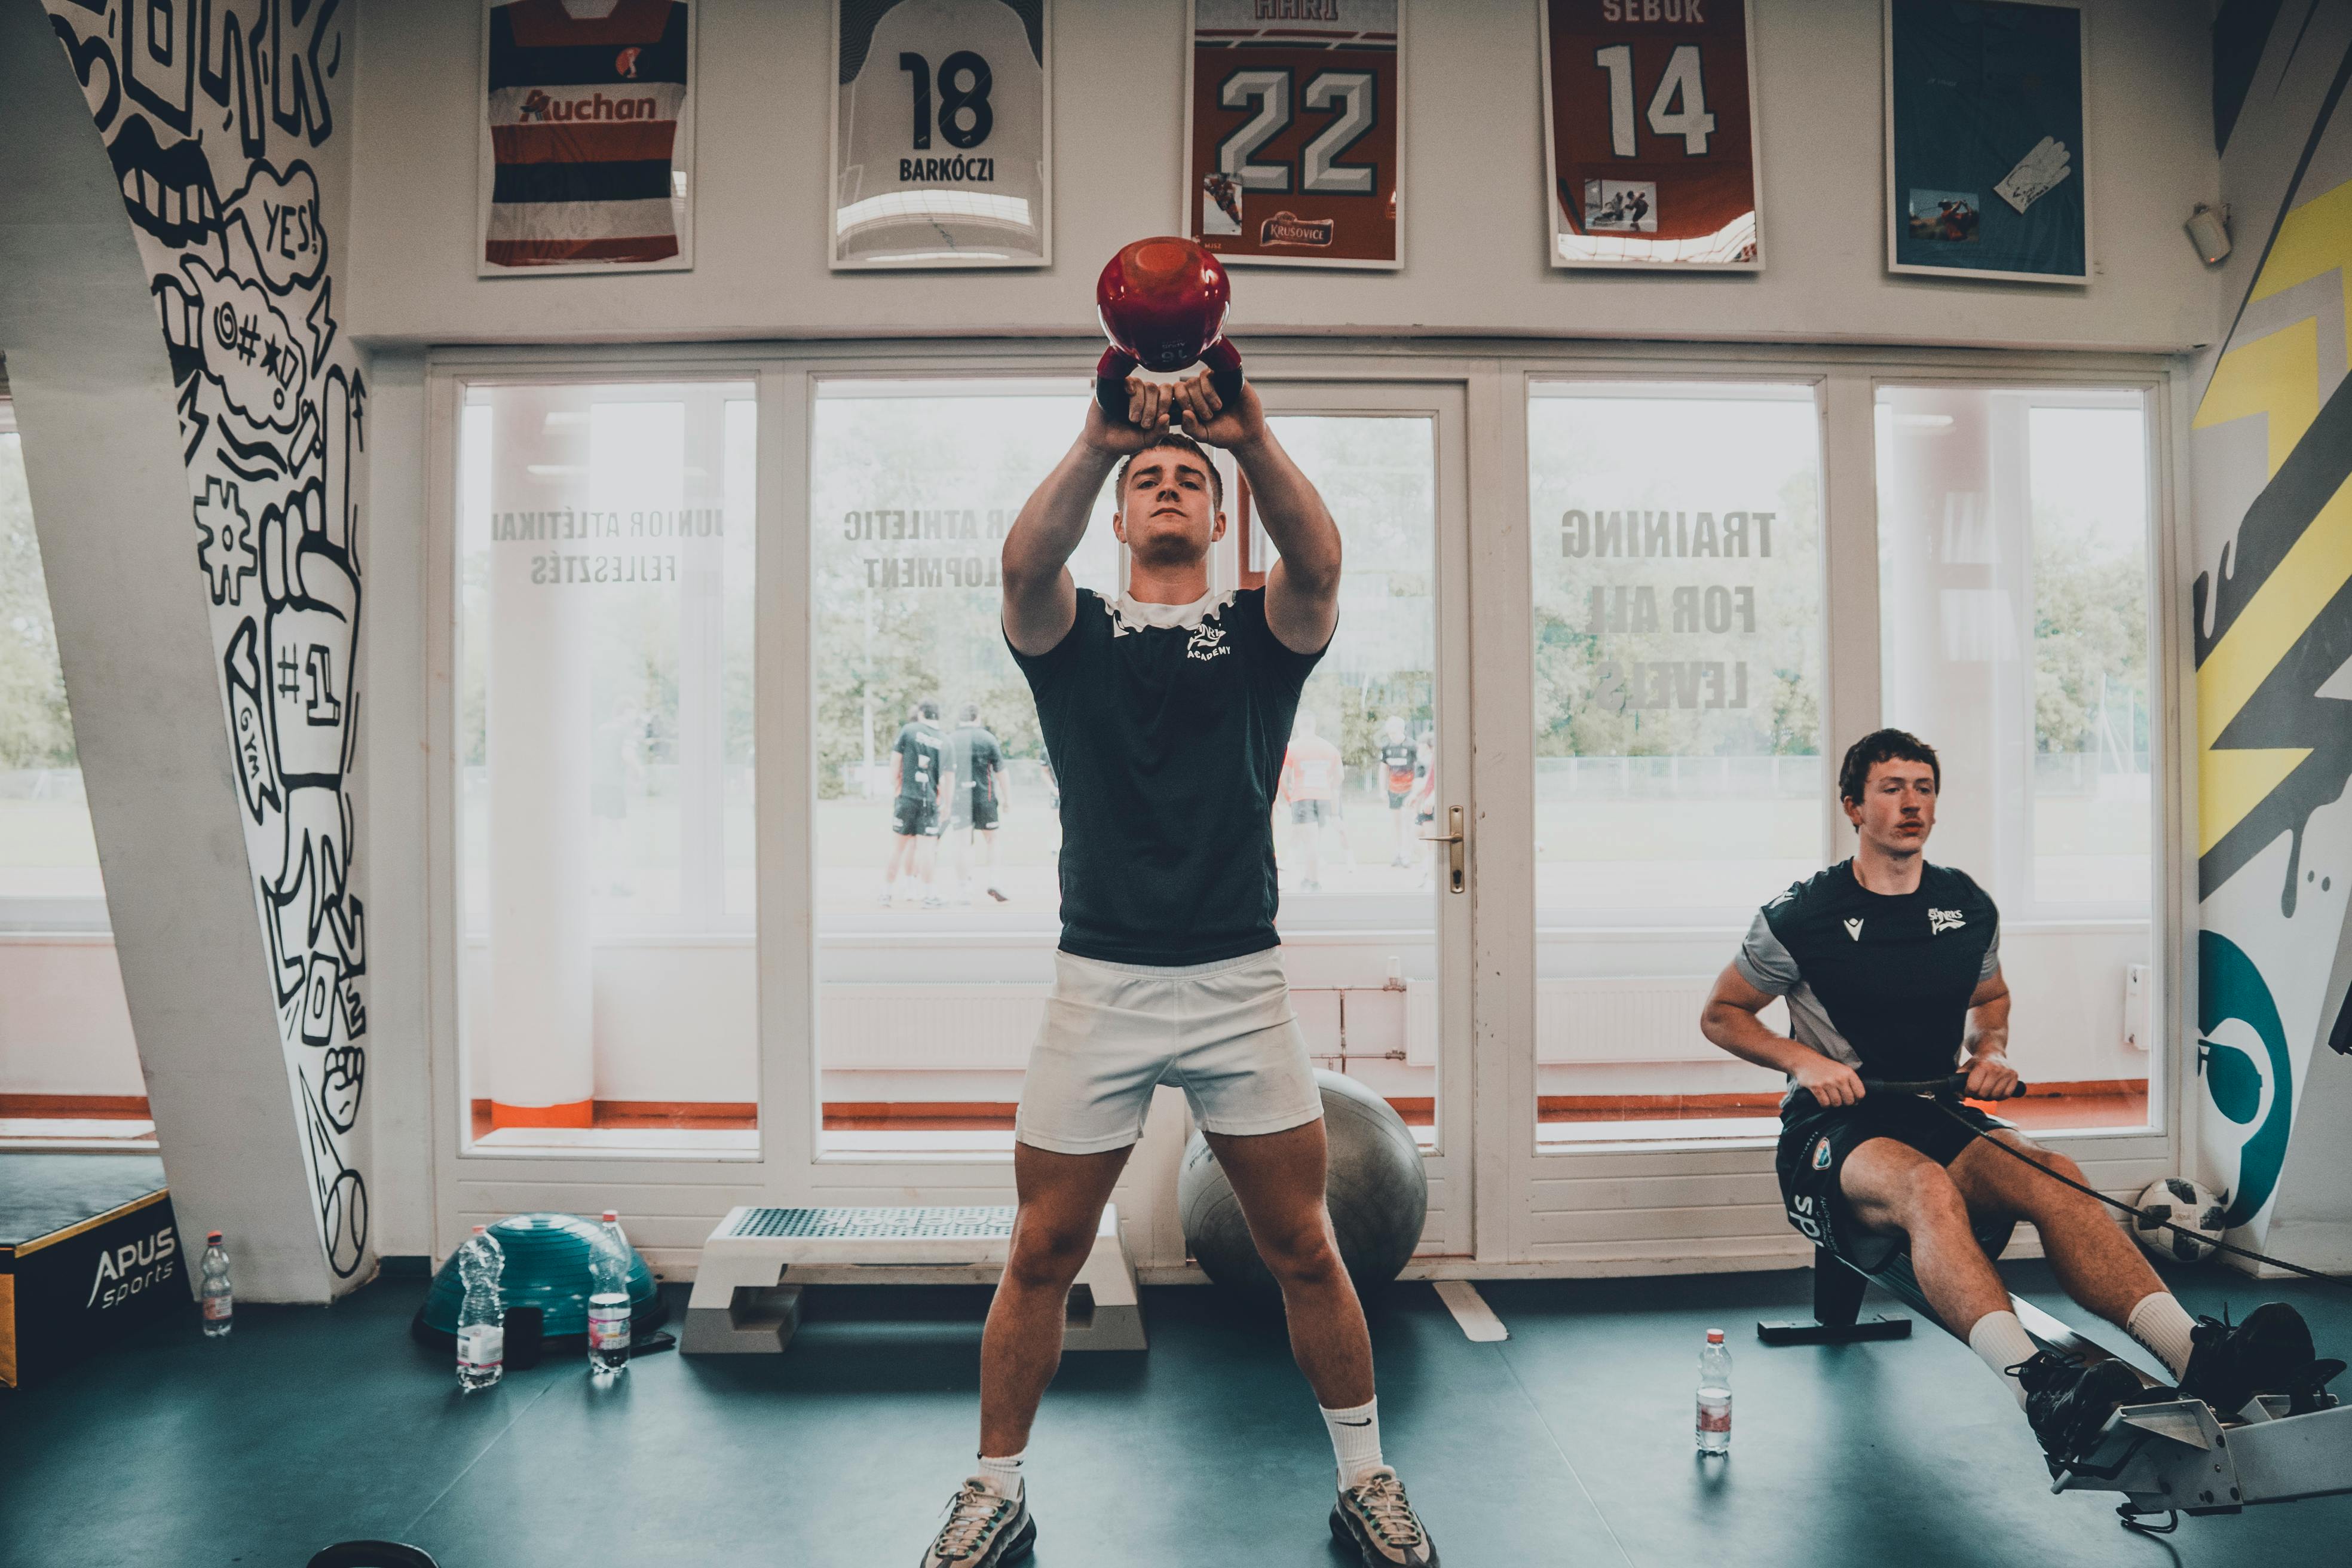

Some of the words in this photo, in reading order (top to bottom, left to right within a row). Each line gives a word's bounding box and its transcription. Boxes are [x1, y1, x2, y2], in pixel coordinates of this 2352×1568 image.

[520, 90, 655, 122] Auchan
[899, 50, 993, 149] 18
[1216, 66, 1377, 196] 22
[1595, 43, 1717, 158] 14
[899, 154, 994, 181] BARKÓCZI
[264, 199, 319, 260] YES!
[277, 643, 341, 726] #1
[1187, 646, 1231, 662] ACADEMY
[240, 707, 259, 779] GYM
[87, 1226, 176, 1309] APUS
[102, 1260, 174, 1309] sports
